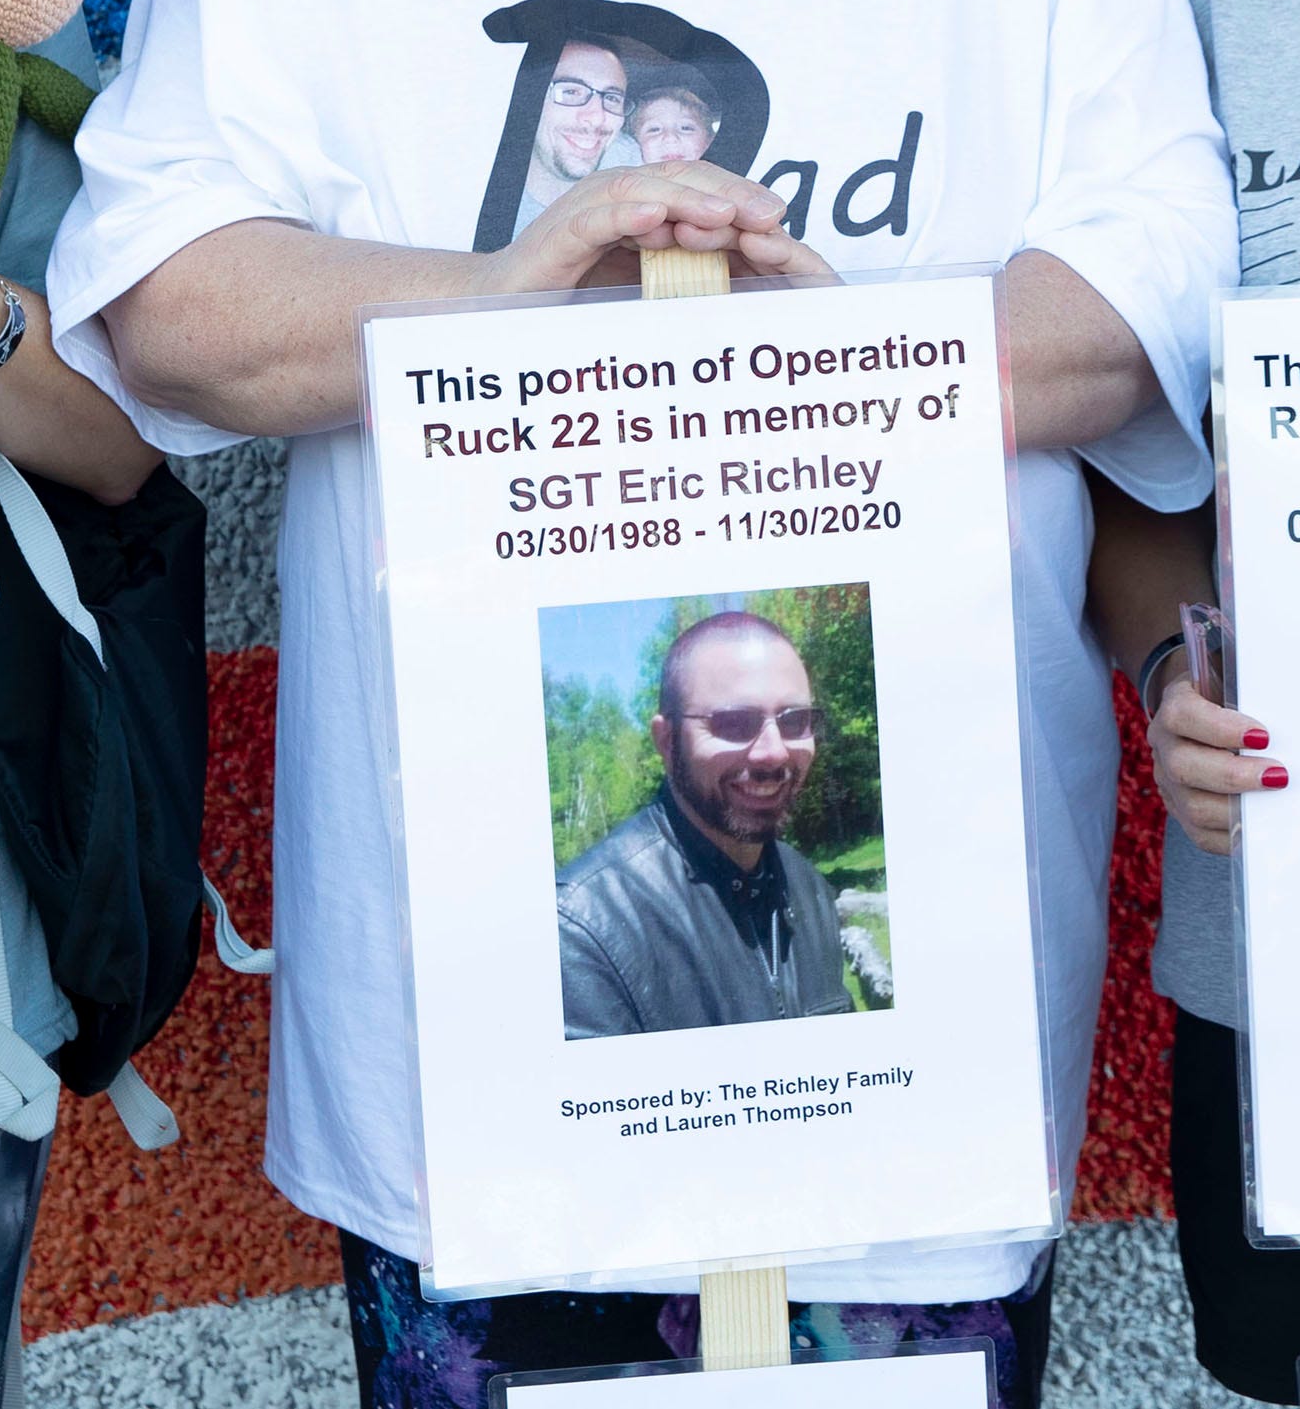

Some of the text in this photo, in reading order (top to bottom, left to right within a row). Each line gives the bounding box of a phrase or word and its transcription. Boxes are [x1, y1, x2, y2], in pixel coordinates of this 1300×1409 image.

[406, 334, 965, 406] This portion of Operation
[423, 384, 960, 458] Ruck 22 is in memory of
[509, 455, 882, 512] SGT Eric Richley
[496, 518, 681, 559] 03/30/1988
[718, 501, 901, 541] 11/30/2020
[561, 1067, 913, 1119] Sponsored by: The Richley Family
[621, 1102, 852, 1136] and Lauren Thompson
